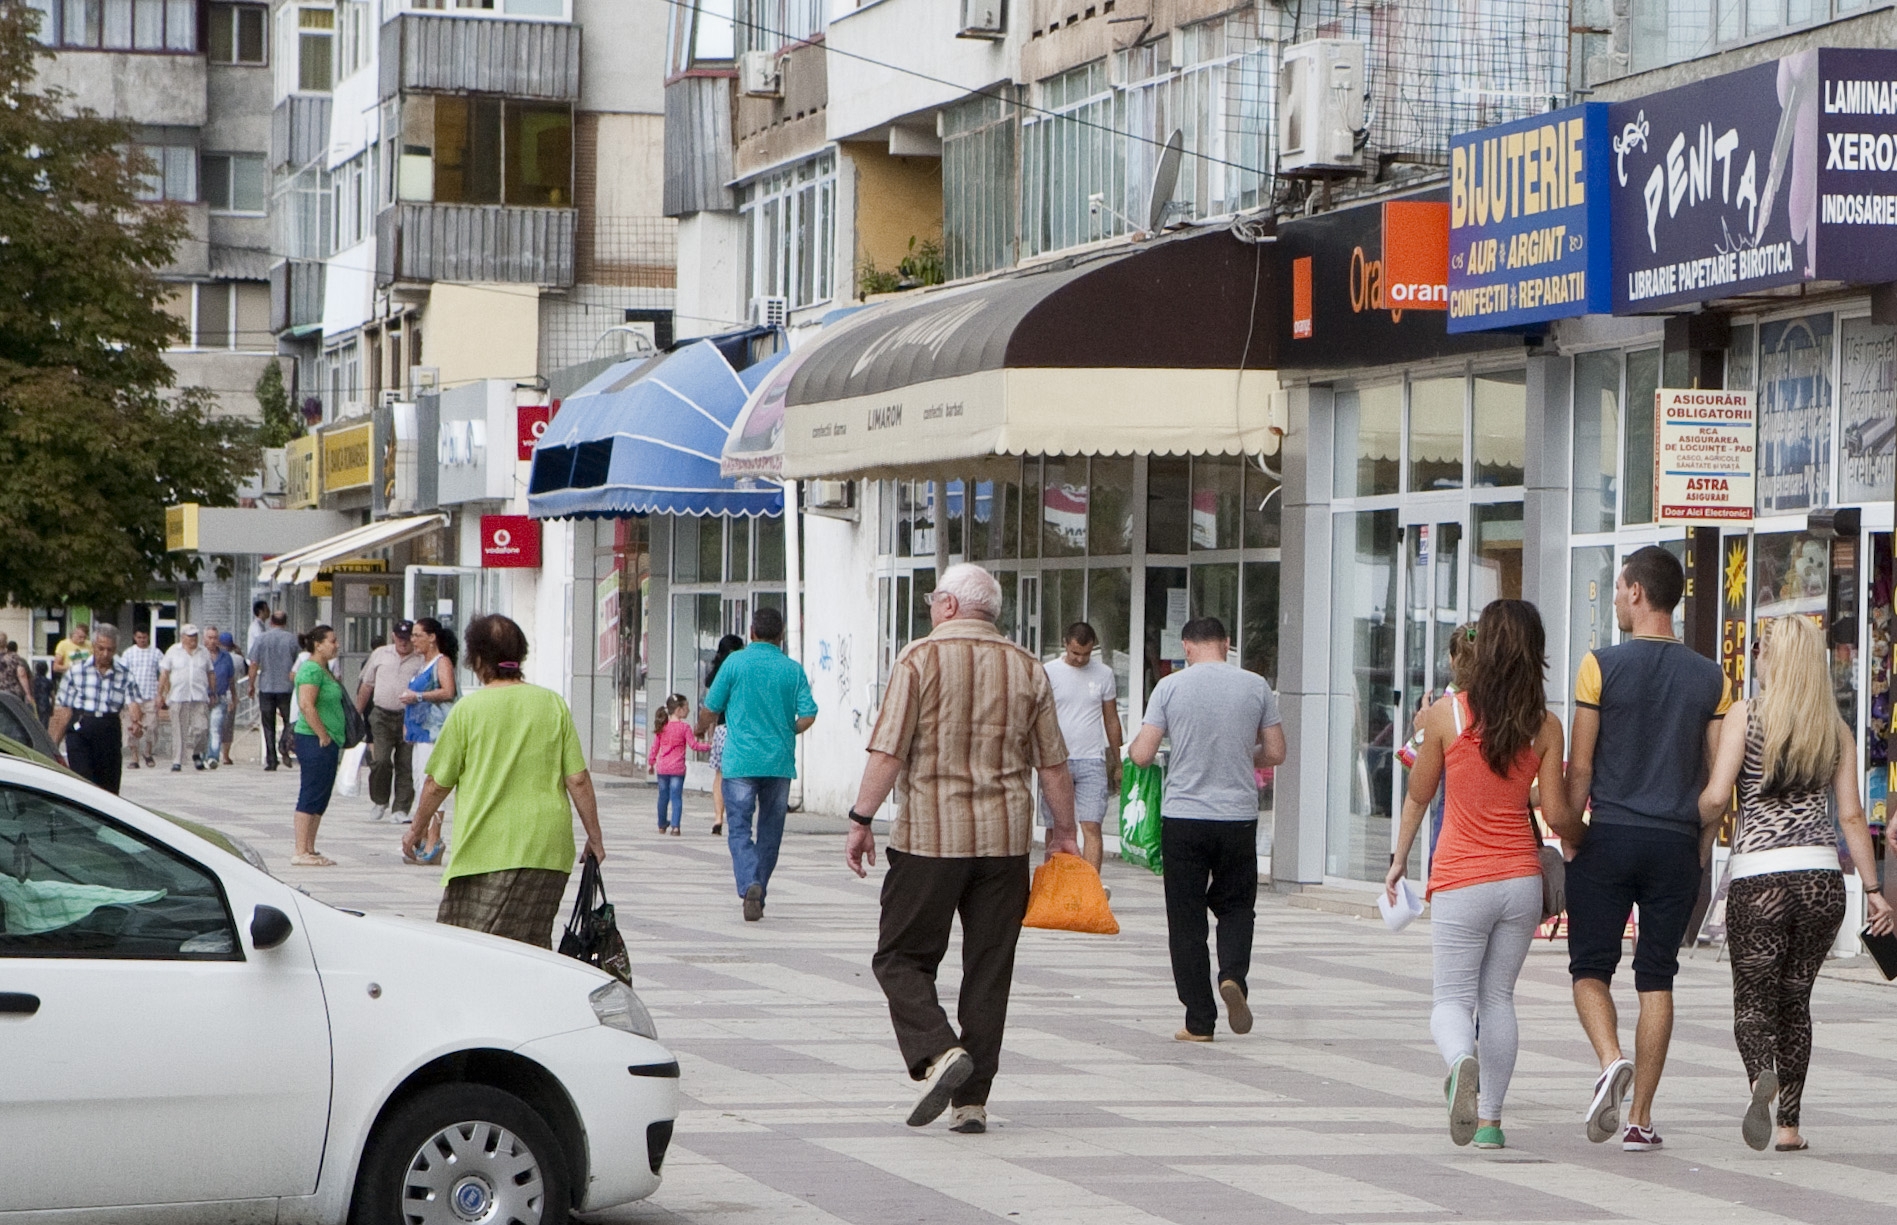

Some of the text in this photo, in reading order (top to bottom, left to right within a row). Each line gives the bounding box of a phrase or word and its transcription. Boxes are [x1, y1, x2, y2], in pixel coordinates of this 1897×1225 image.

[1826, 132, 1897, 171] XERO
[1451, 117, 1585, 230] BIJUTERIE
[1643, 121, 1758, 253] PENITA
[1822, 194, 1897, 225] INDOSARIE
[1466, 225, 1566, 276] AUR ARGINT
[1629, 241, 1793, 301] LIBRARIE PAPETARIE BIROTICA
[1450, 271, 1585, 319] CONFECTII REPARATII
[867, 403, 903, 431] LIMAROM
[1667, 408, 1752, 419] OBLIGATORII
[1687, 478, 1729, 490] ASTRA
[1665, 507, 1750, 517] Doar Aici Electronic!
